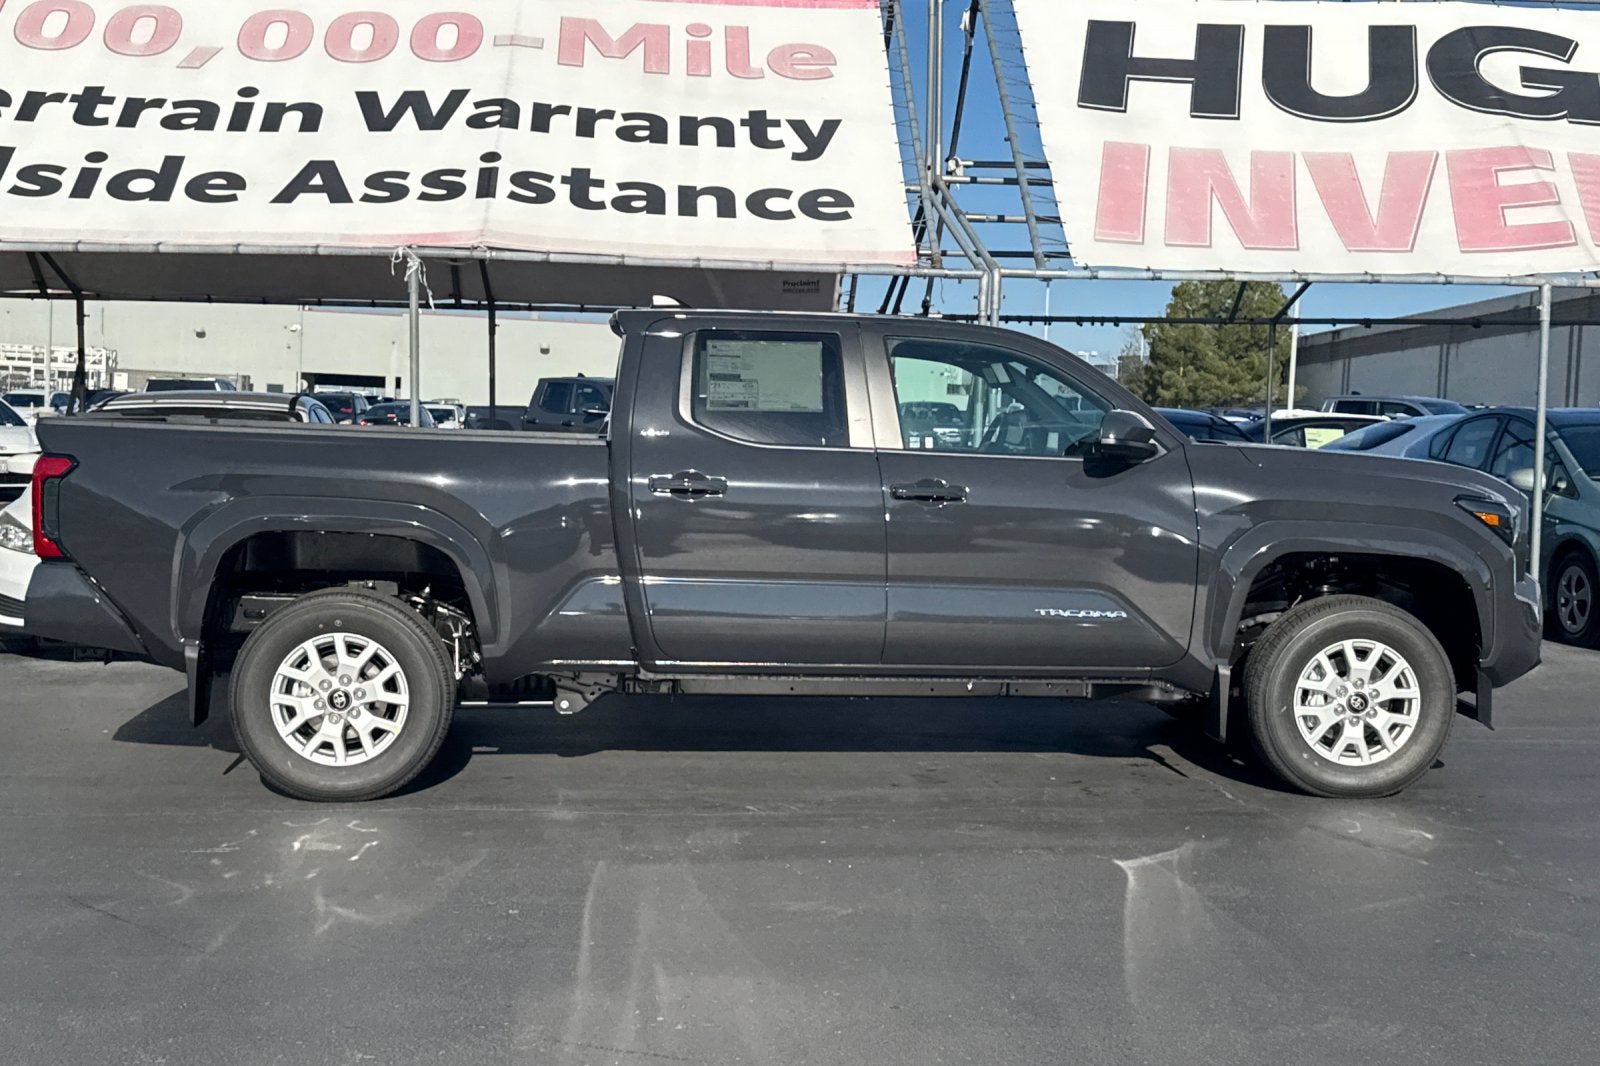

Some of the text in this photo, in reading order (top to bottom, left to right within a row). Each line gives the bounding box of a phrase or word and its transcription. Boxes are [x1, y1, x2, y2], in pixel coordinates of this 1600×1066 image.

[0, 0, 838, 81] 00,000-Mile
[1077, 19, 1600, 126] HUG
[0, 86, 842, 162] rtrain Warranty
[0, 146, 855, 222] side Assistance
[1093, 140, 1600, 255] INVE
[1035, 608, 1128, 618] TACOMA
